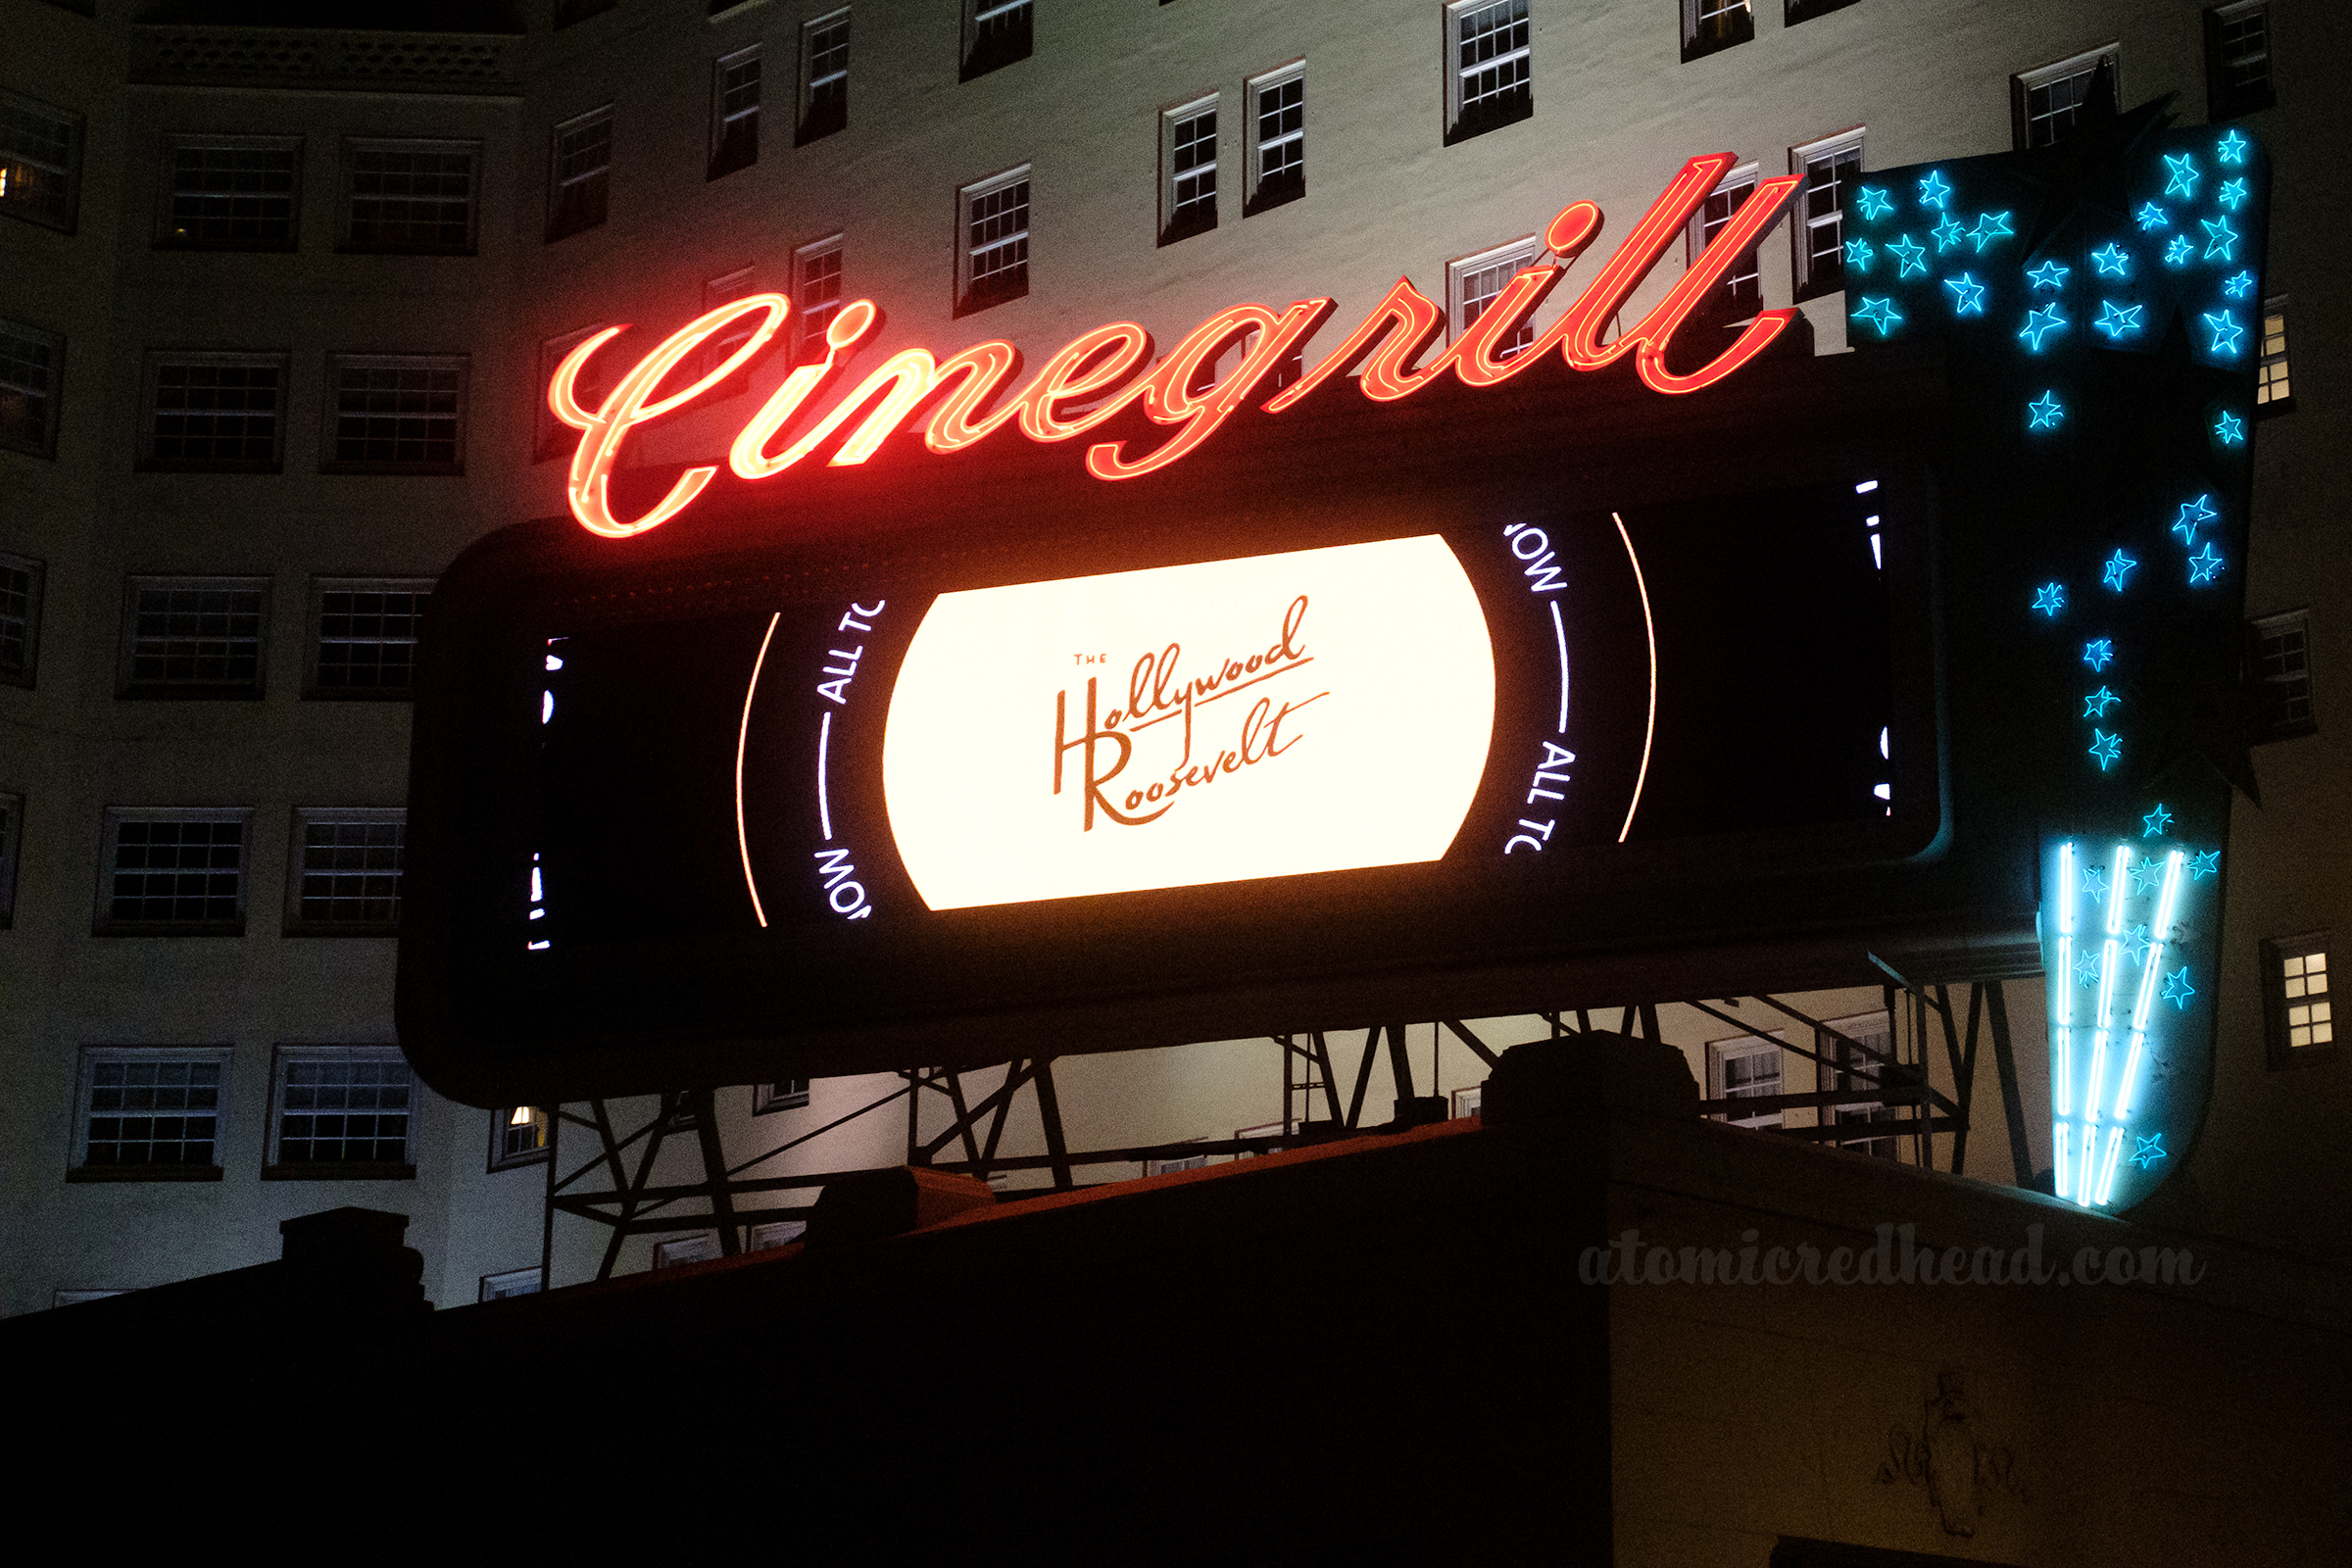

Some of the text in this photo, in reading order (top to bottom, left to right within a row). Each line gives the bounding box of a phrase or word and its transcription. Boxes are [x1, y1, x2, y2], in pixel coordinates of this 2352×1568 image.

[547, 151, 1810, 539] Cinegrill
[816, 645, 863, 705] ALL
[1054, 594, 1309, 795] Hollywood
[1073, 653, 1106, 665] THE
[1084, 692, 1330, 833] Roosevelt
[1526, 740, 1577, 805] ALL
